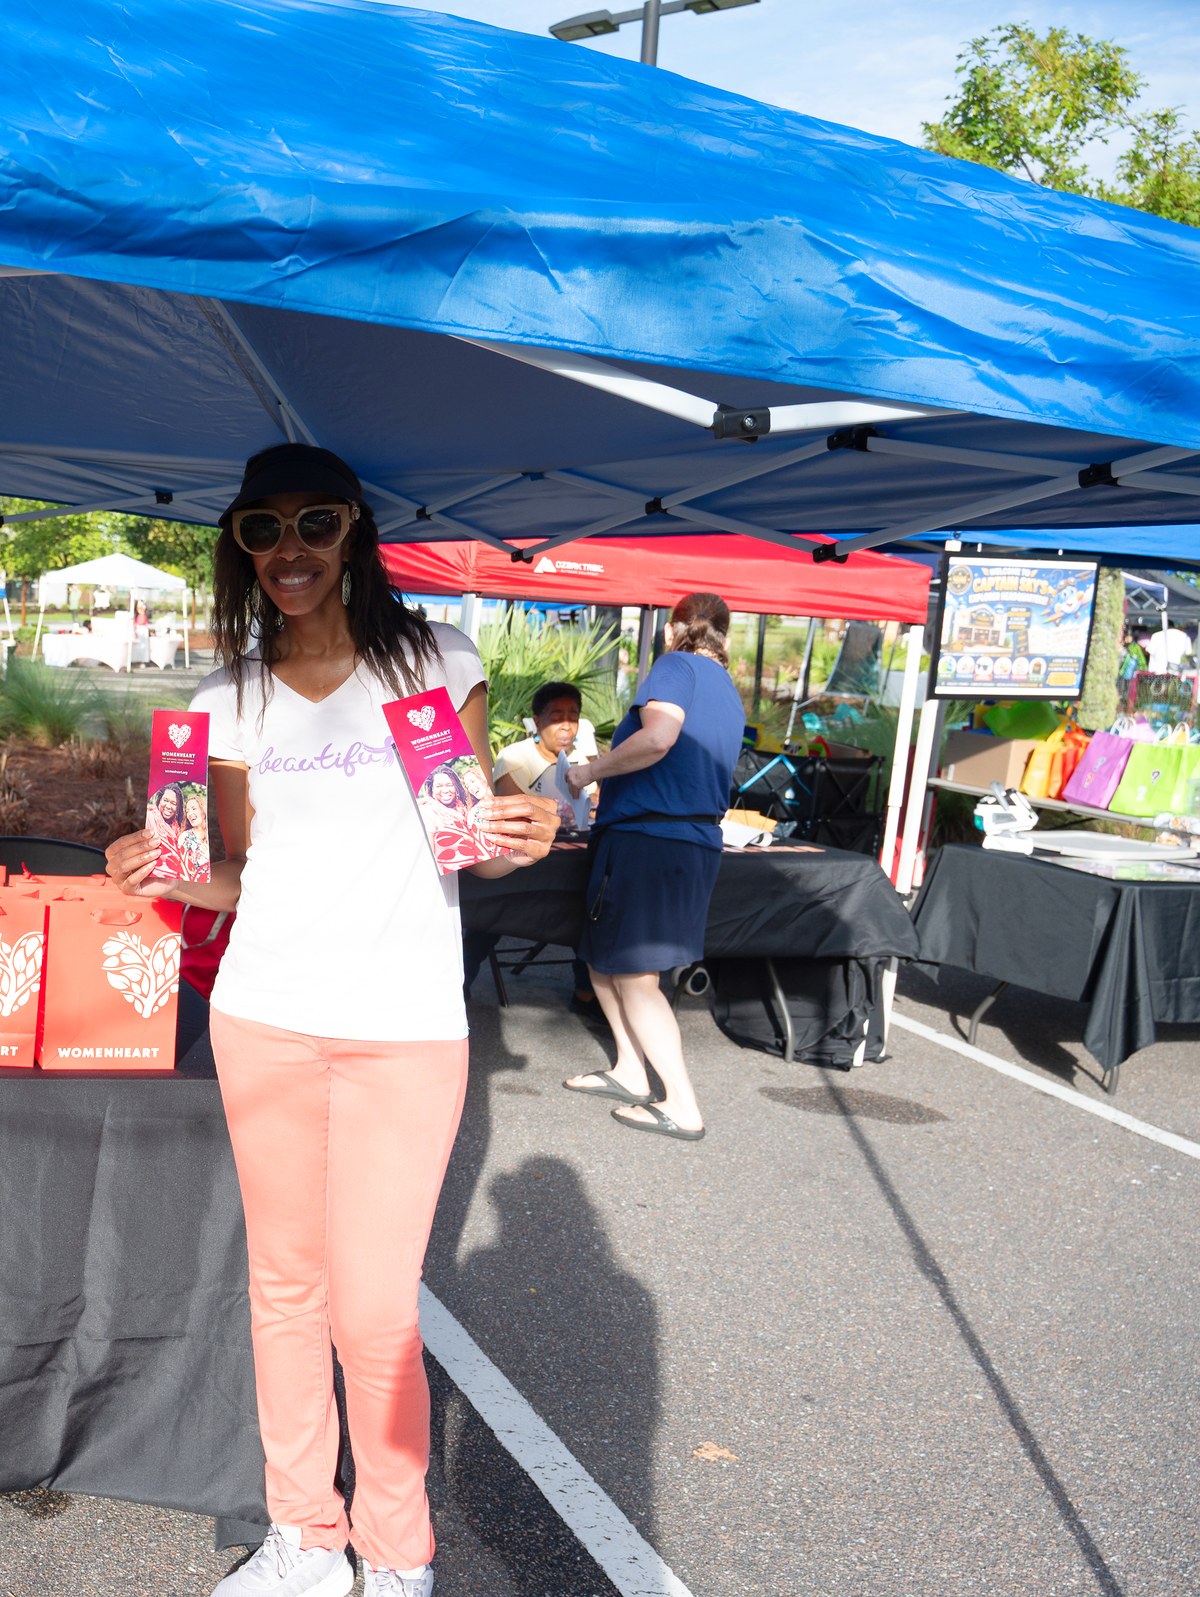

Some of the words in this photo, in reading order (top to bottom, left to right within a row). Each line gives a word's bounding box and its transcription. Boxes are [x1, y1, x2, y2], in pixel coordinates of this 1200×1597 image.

[972, 575, 1019, 593] CAPTAIN
[410, 729, 451, 746] WOMENHEART
[161, 751, 196, 759] WOMENHEART
[57, 1047, 160, 1059] WOMENHEART
